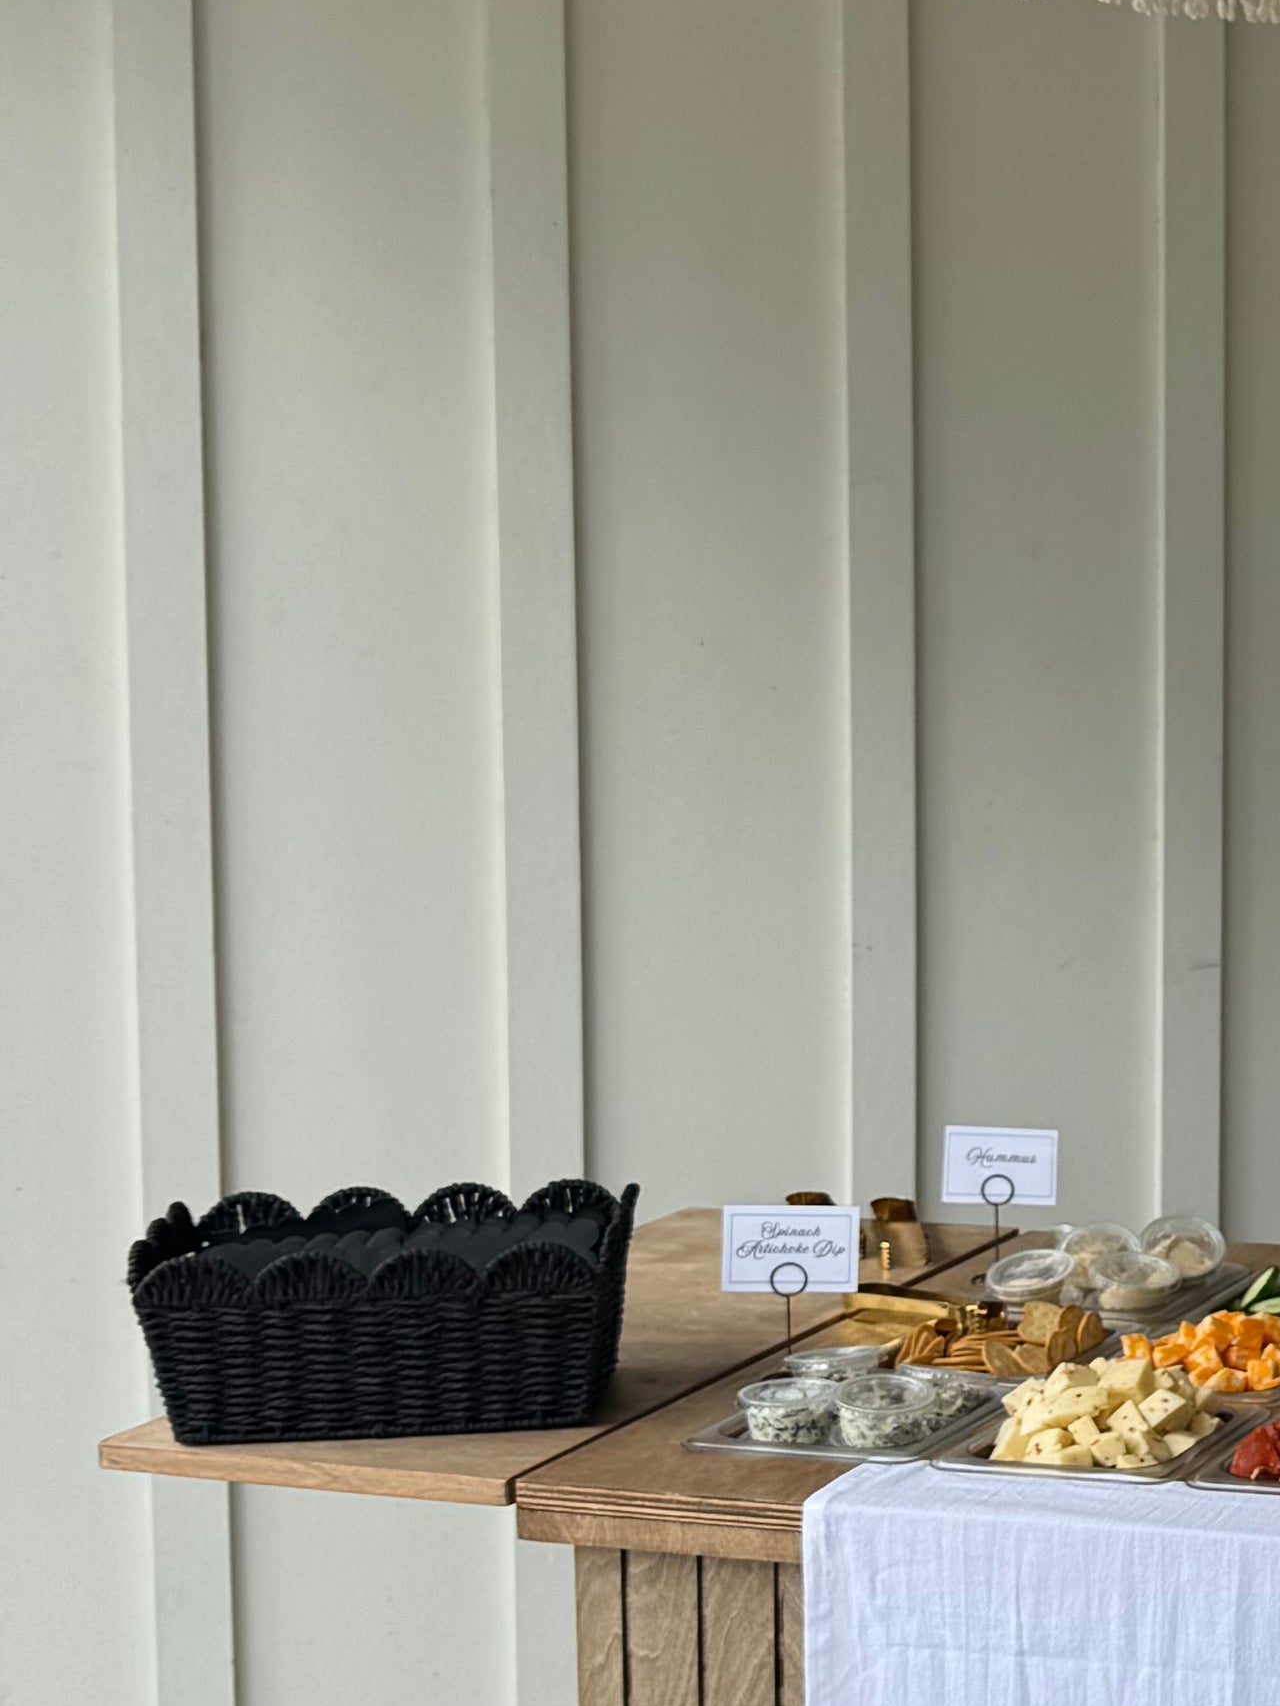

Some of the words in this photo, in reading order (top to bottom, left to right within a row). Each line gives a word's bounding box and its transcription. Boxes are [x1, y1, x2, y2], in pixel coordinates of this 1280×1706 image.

[966, 1146, 1037, 1169] Hummus
[761, 1221, 821, 1240] Spinach
[735, 1239, 810, 1260] Artichoke
[812, 1239, 846, 1258] Dip
